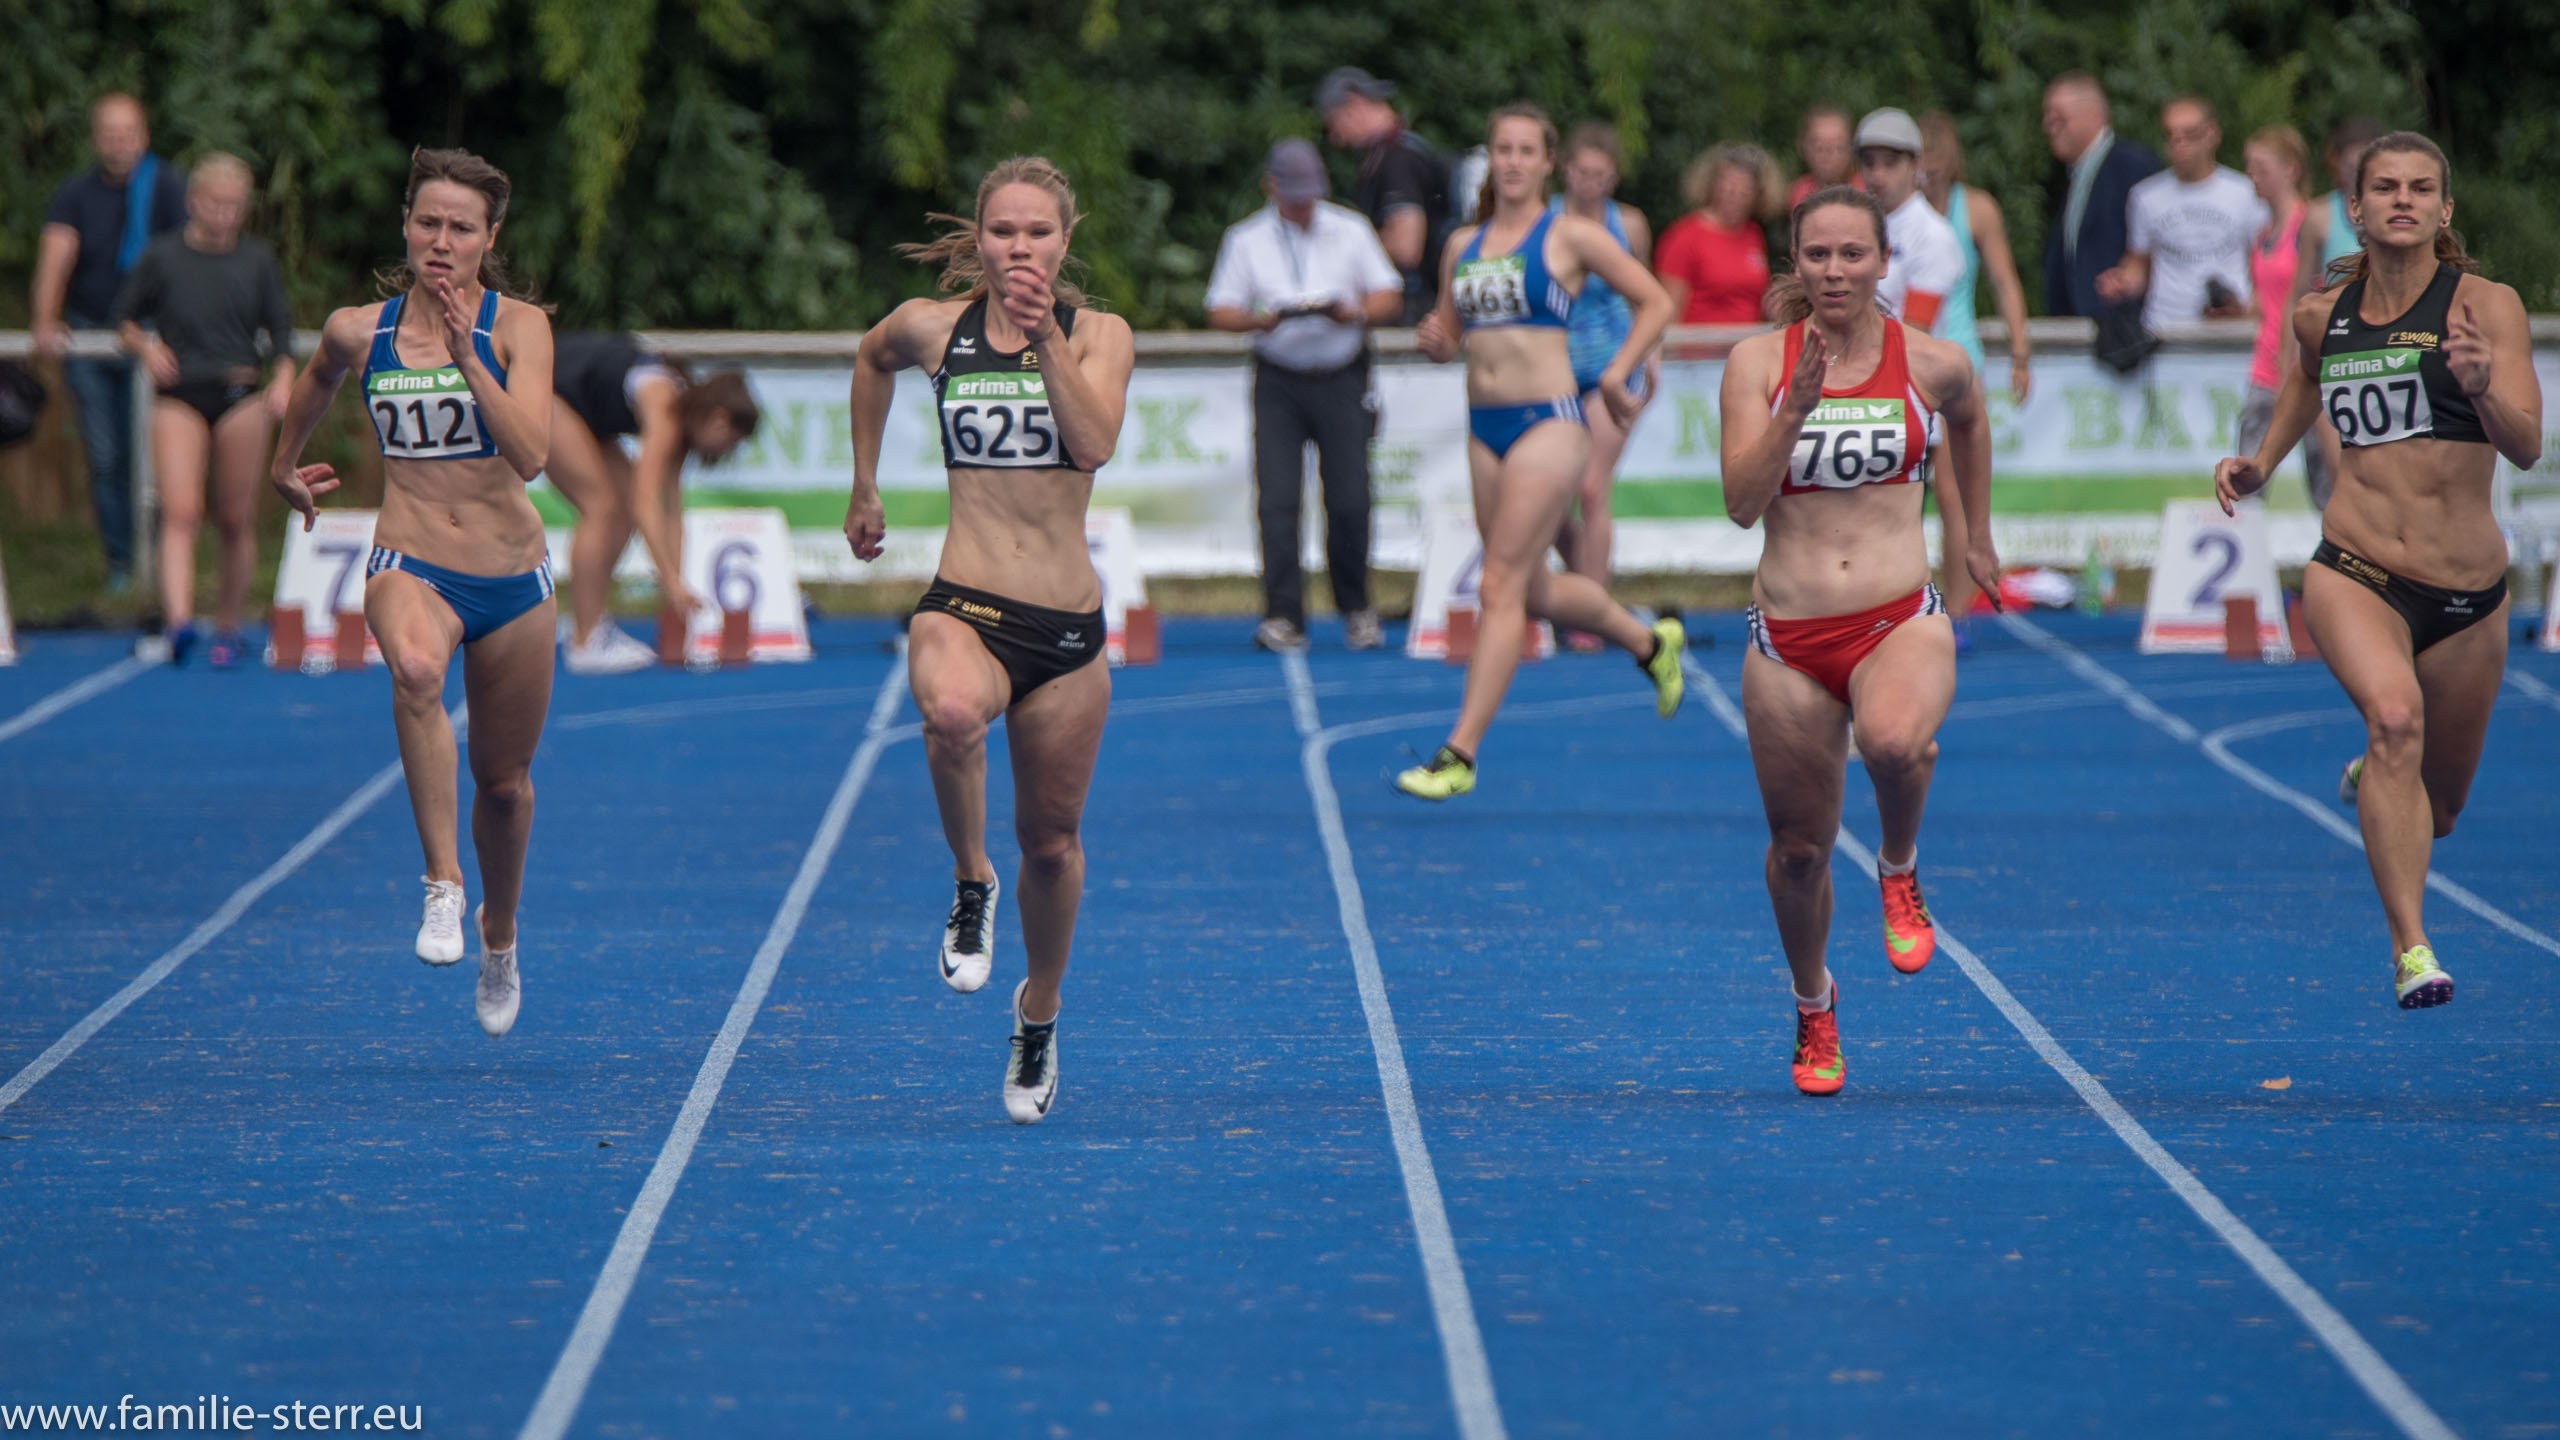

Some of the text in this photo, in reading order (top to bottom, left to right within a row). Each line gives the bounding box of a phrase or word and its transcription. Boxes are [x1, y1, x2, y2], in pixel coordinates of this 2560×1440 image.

[376, 373, 435, 391] erima
[957, 378, 1019, 395] erima
[2329, 358, 2384, 377] erima
[375, 397, 473, 450] 212
[952, 405, 1053, 459] 625
[2329, 379, 2418, 439] 607
[1798, 429, 1898, 481] 765
[312, 540, 364, 615] 7
[709, 539, 759, 612] 6
[2186, 528, 2240, 611] 2
